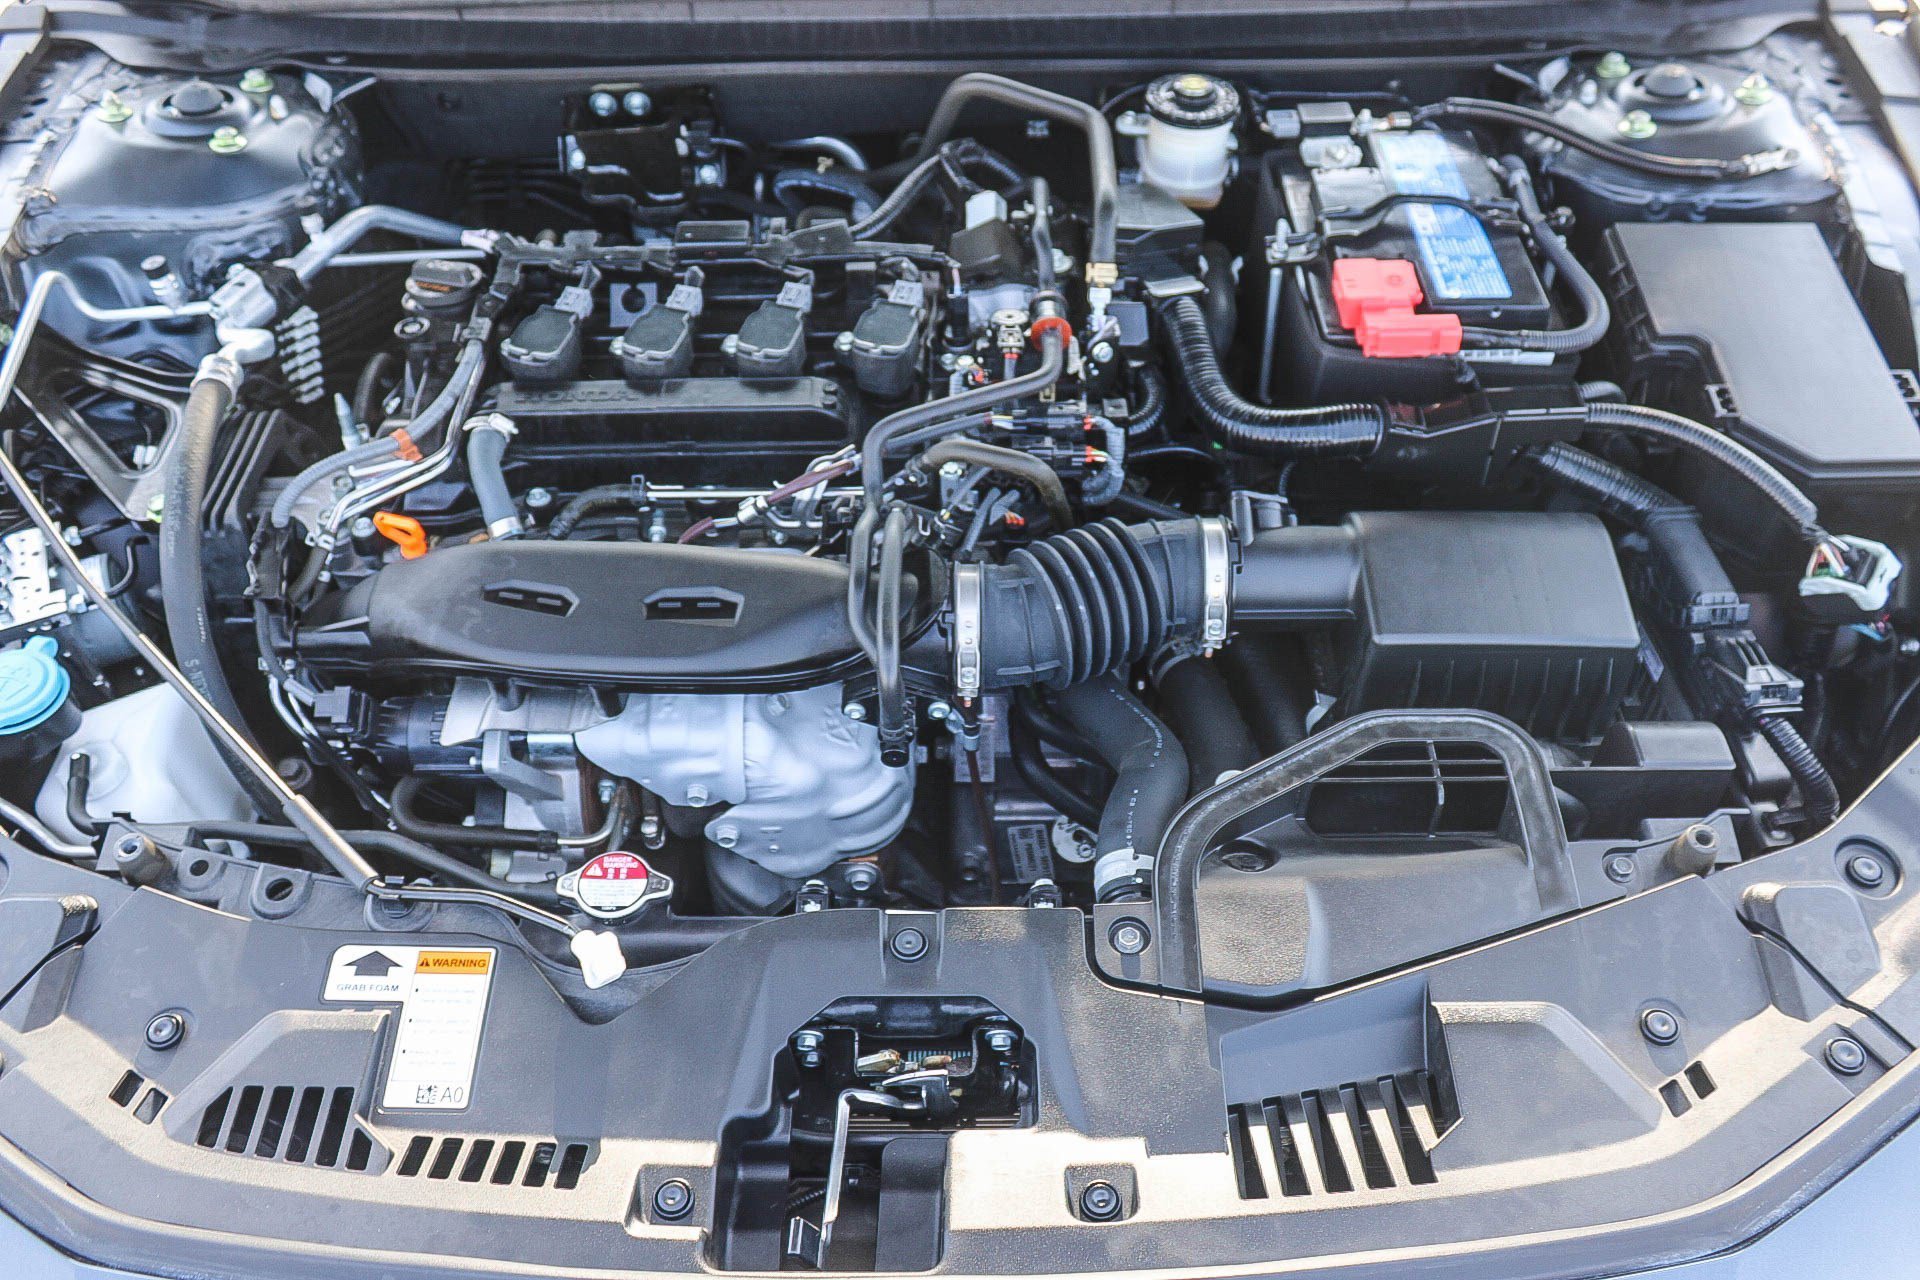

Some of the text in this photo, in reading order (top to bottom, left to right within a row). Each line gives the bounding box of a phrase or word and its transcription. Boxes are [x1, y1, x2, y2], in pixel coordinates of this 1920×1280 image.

[514, 390, 639, 404] HONDA
[432, 957, 487, 969] WARNING
[336, 983, 400, 993] GRAB FOAM
